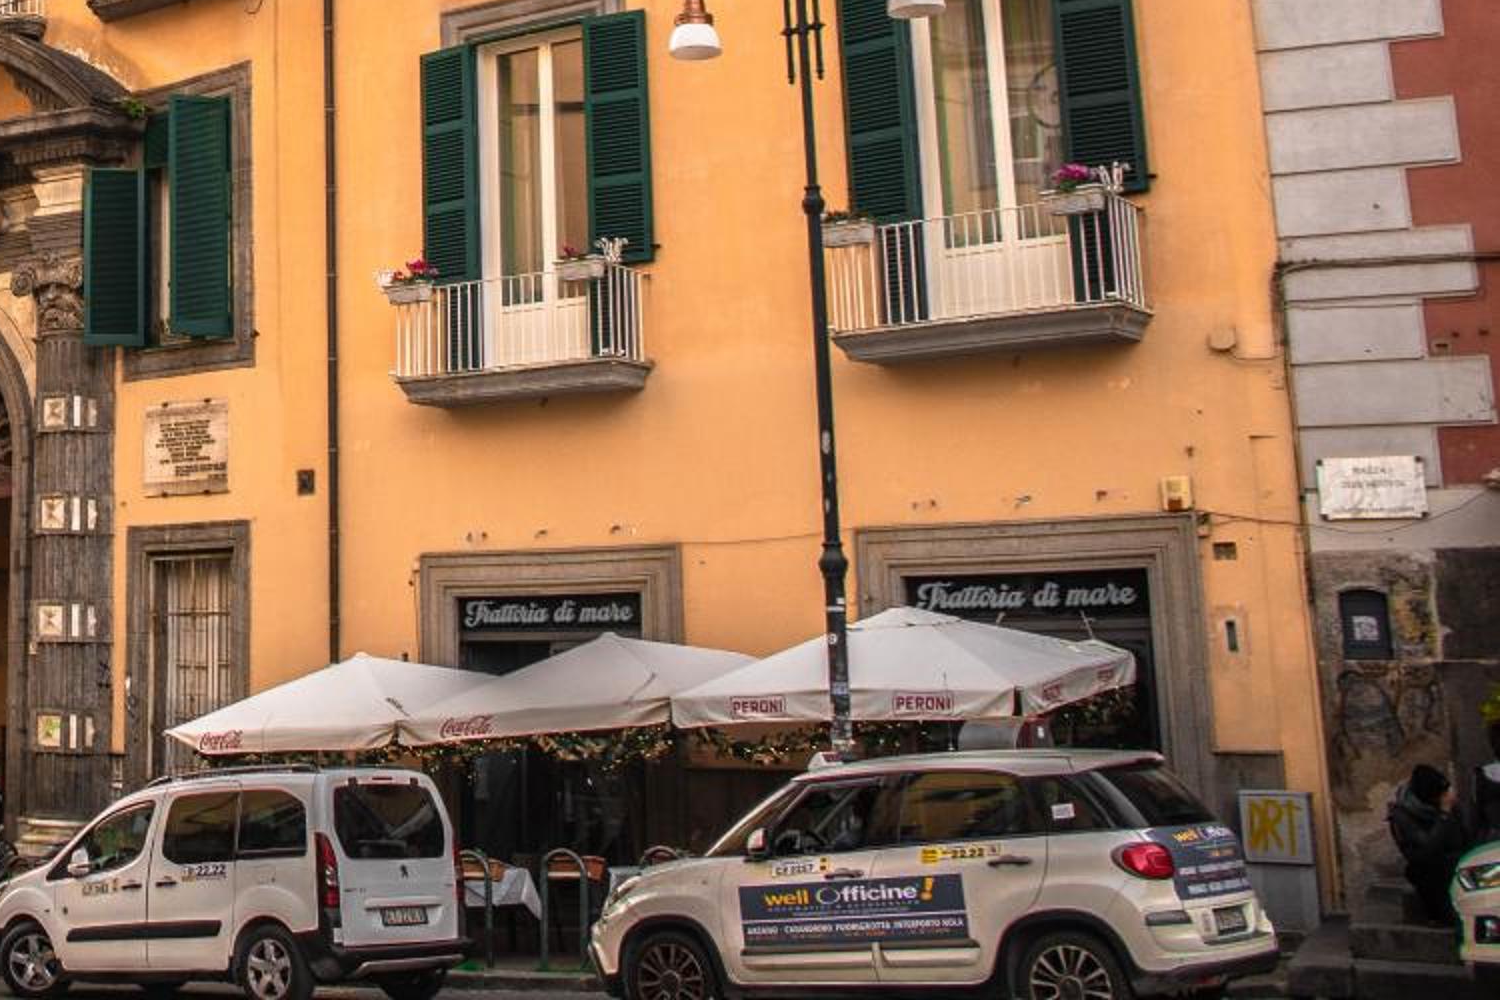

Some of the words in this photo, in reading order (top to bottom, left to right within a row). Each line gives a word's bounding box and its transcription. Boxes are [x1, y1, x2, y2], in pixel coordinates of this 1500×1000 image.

[916, 582, 1025, 611] Trattoria
[1032, 581, 1061, 608] di
[1064, 583, 1138, 607] mare
[464, 601, 549, 628] Trattoria
[553, 600, 576, 623] di
[578, 602, 634, 623] mare
[732, 699, 784, 713] PERONI
[895, 695, 951, 711] PERONI
[763, 888, 811, 906] well
